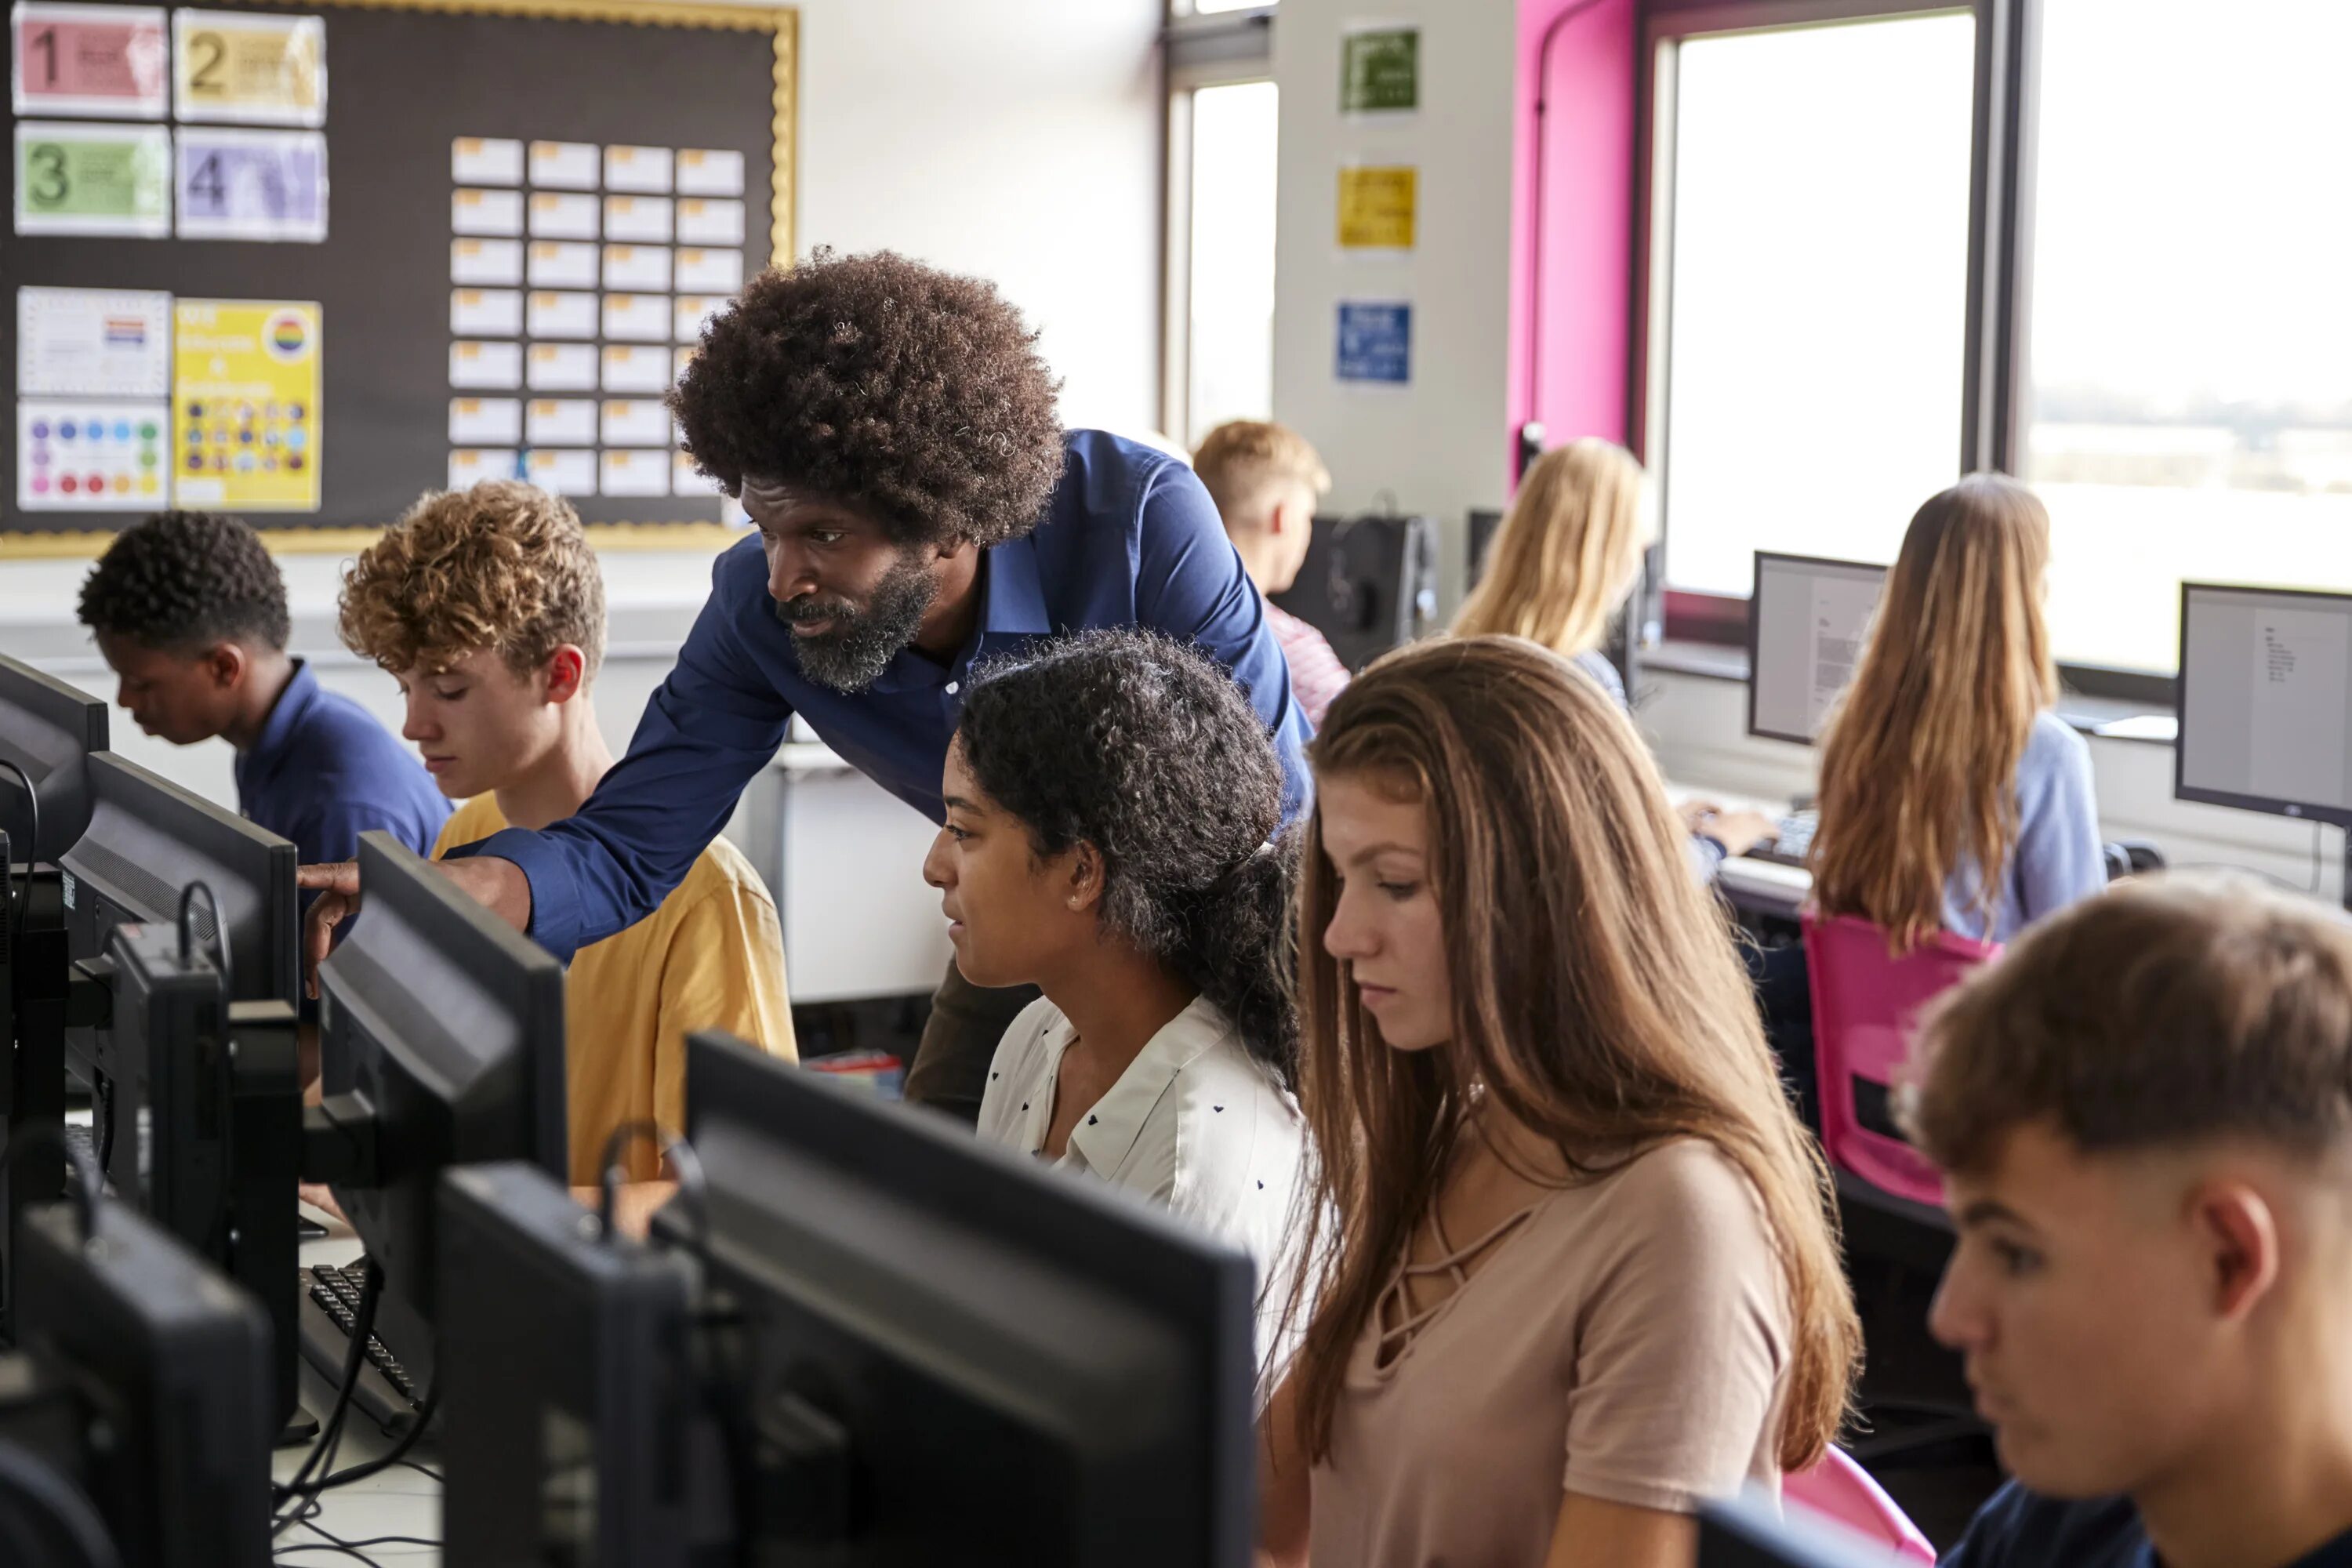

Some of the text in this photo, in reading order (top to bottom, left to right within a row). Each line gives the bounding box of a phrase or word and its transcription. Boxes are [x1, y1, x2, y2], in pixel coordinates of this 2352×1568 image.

[31, 26, 59, 88] 1
[190, 31, 227, 95] 2
[31, 143, 69, 207] 3
[188, 149, 225, 209] 4
